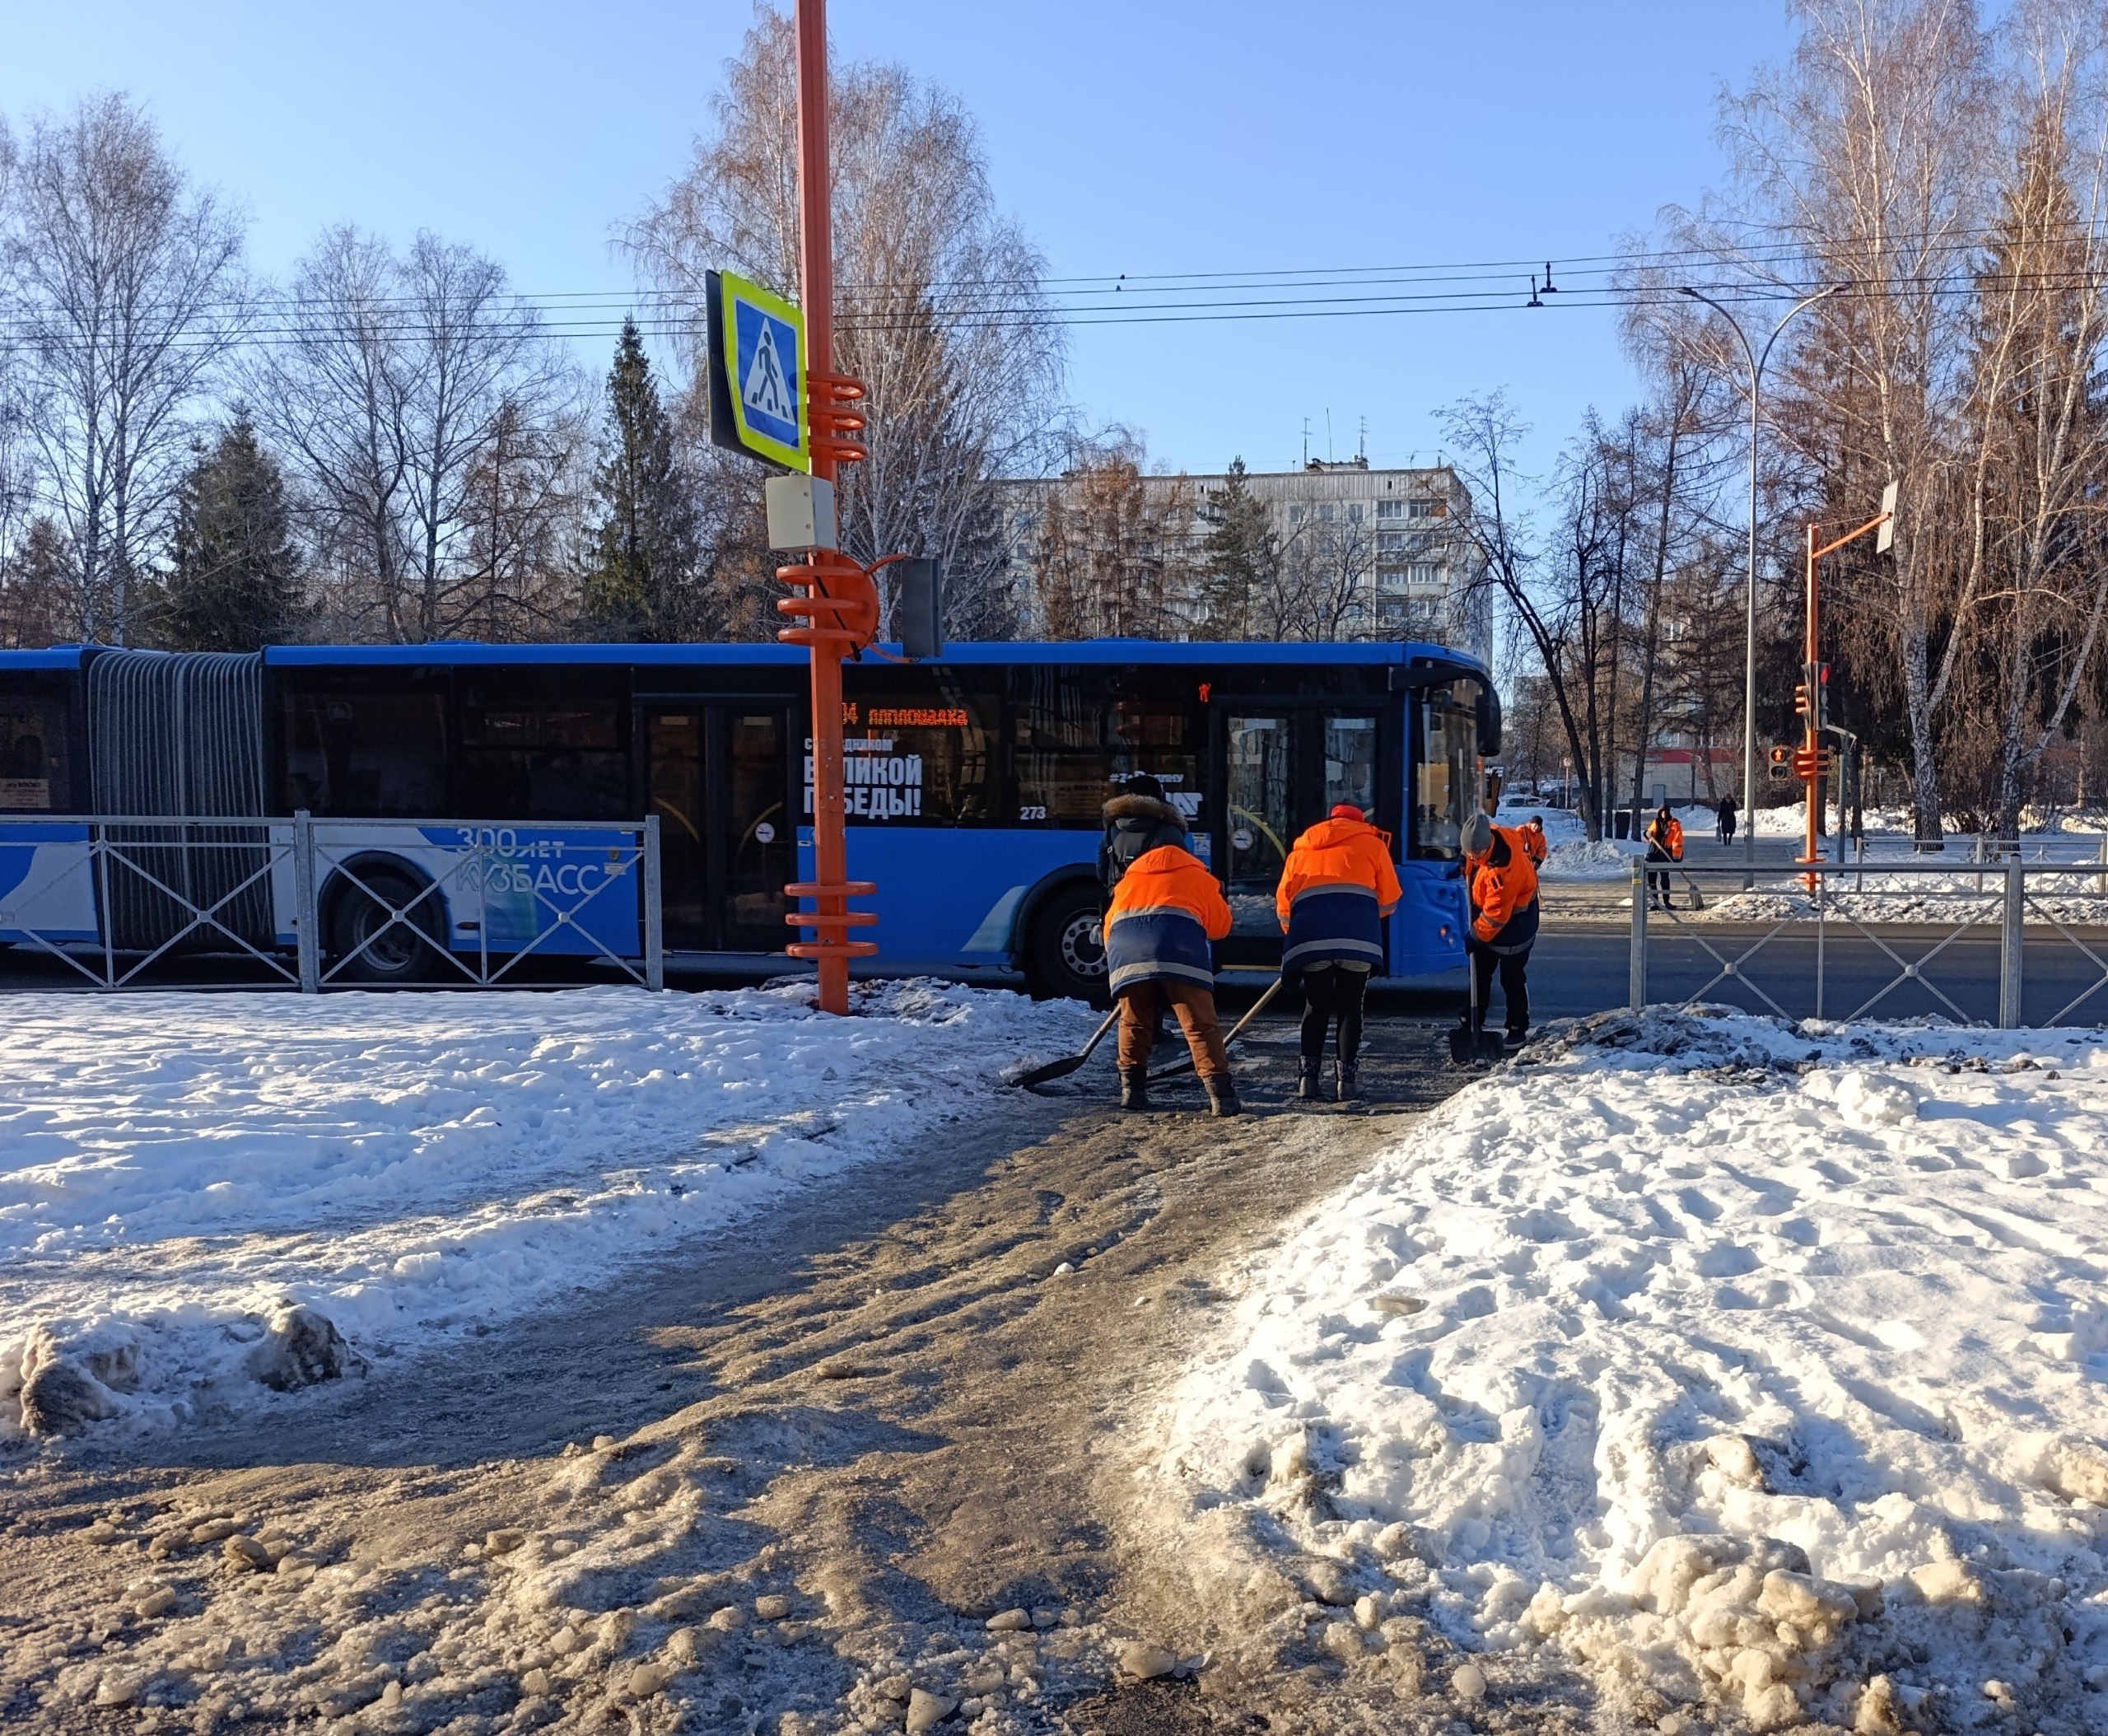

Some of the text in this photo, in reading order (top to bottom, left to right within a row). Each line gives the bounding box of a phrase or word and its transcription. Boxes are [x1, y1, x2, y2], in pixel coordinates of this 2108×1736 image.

[804, 754, 923, 786] ВЛИКОЙ
[804, 786, 921, 820] ПБЕДЫ!
[1019, 805, 1047, 820] 273
[456, 827, 516, 857] 300
[455, 862, 599, 896] КУЗБАСС
